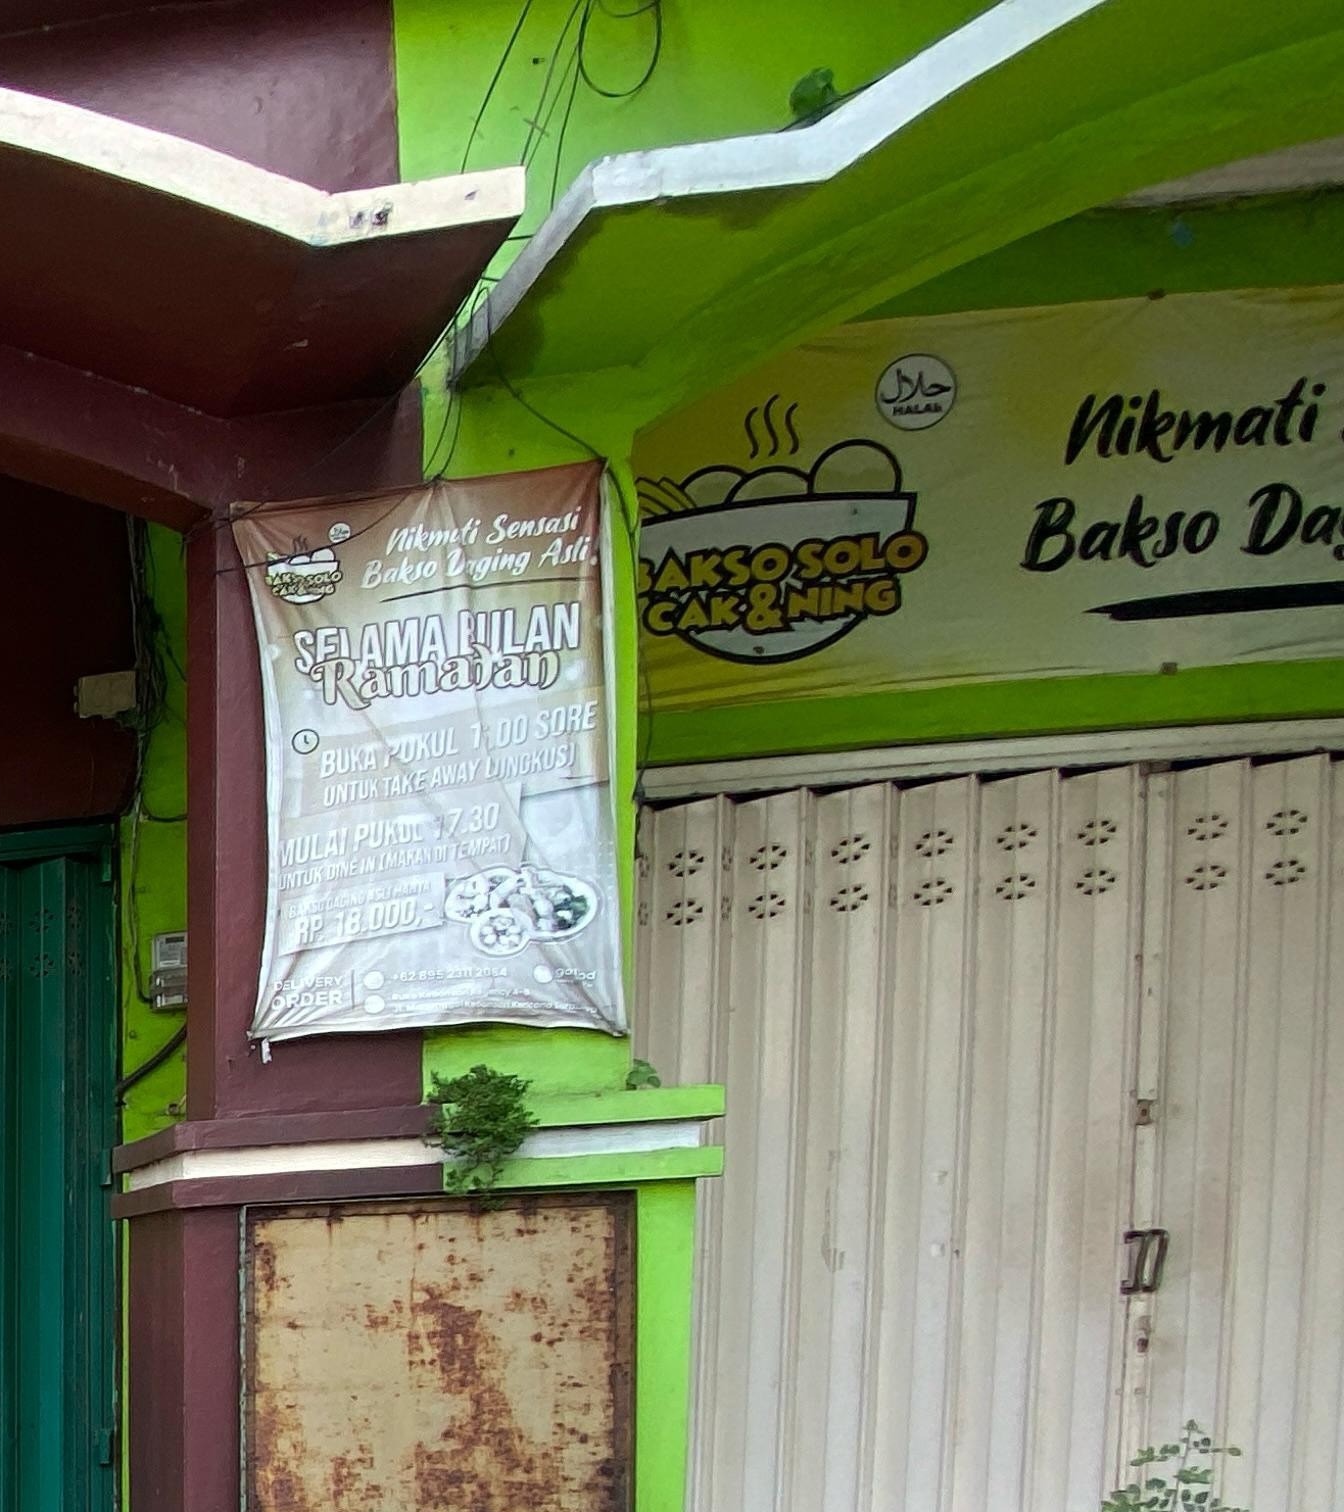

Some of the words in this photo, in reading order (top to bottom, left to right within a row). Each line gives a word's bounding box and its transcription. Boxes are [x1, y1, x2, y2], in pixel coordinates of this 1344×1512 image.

[1064, 375, 1327, 466] Nikmati
[486, 506, 582, 545] Sensasi
[1020, 494, 1220, 573] Bakso
[361, 557, 436, 588] Bakso
[795, 531, 927, 579] SOLO
[643, 592, 743, 636] CAK
[744, 582, 785, 634] &
[787, 576, 901, 619] NING
[293, 614, 447, 674] SELAMA
[311, 641, 560, 710] Ramadan
[320, 747, 378, 779] BUKA
[535, 700, 598, 740] SORE
[323, 780, 378, 808] UNTUK
[383, 771, 427, 797] TAKE
[431, 758, 481, 788] AWAY
[327, 860, 358, 880] DINE
[360, 856, 377, 874] IN
[272, 989, 343, 1010] ORDER
